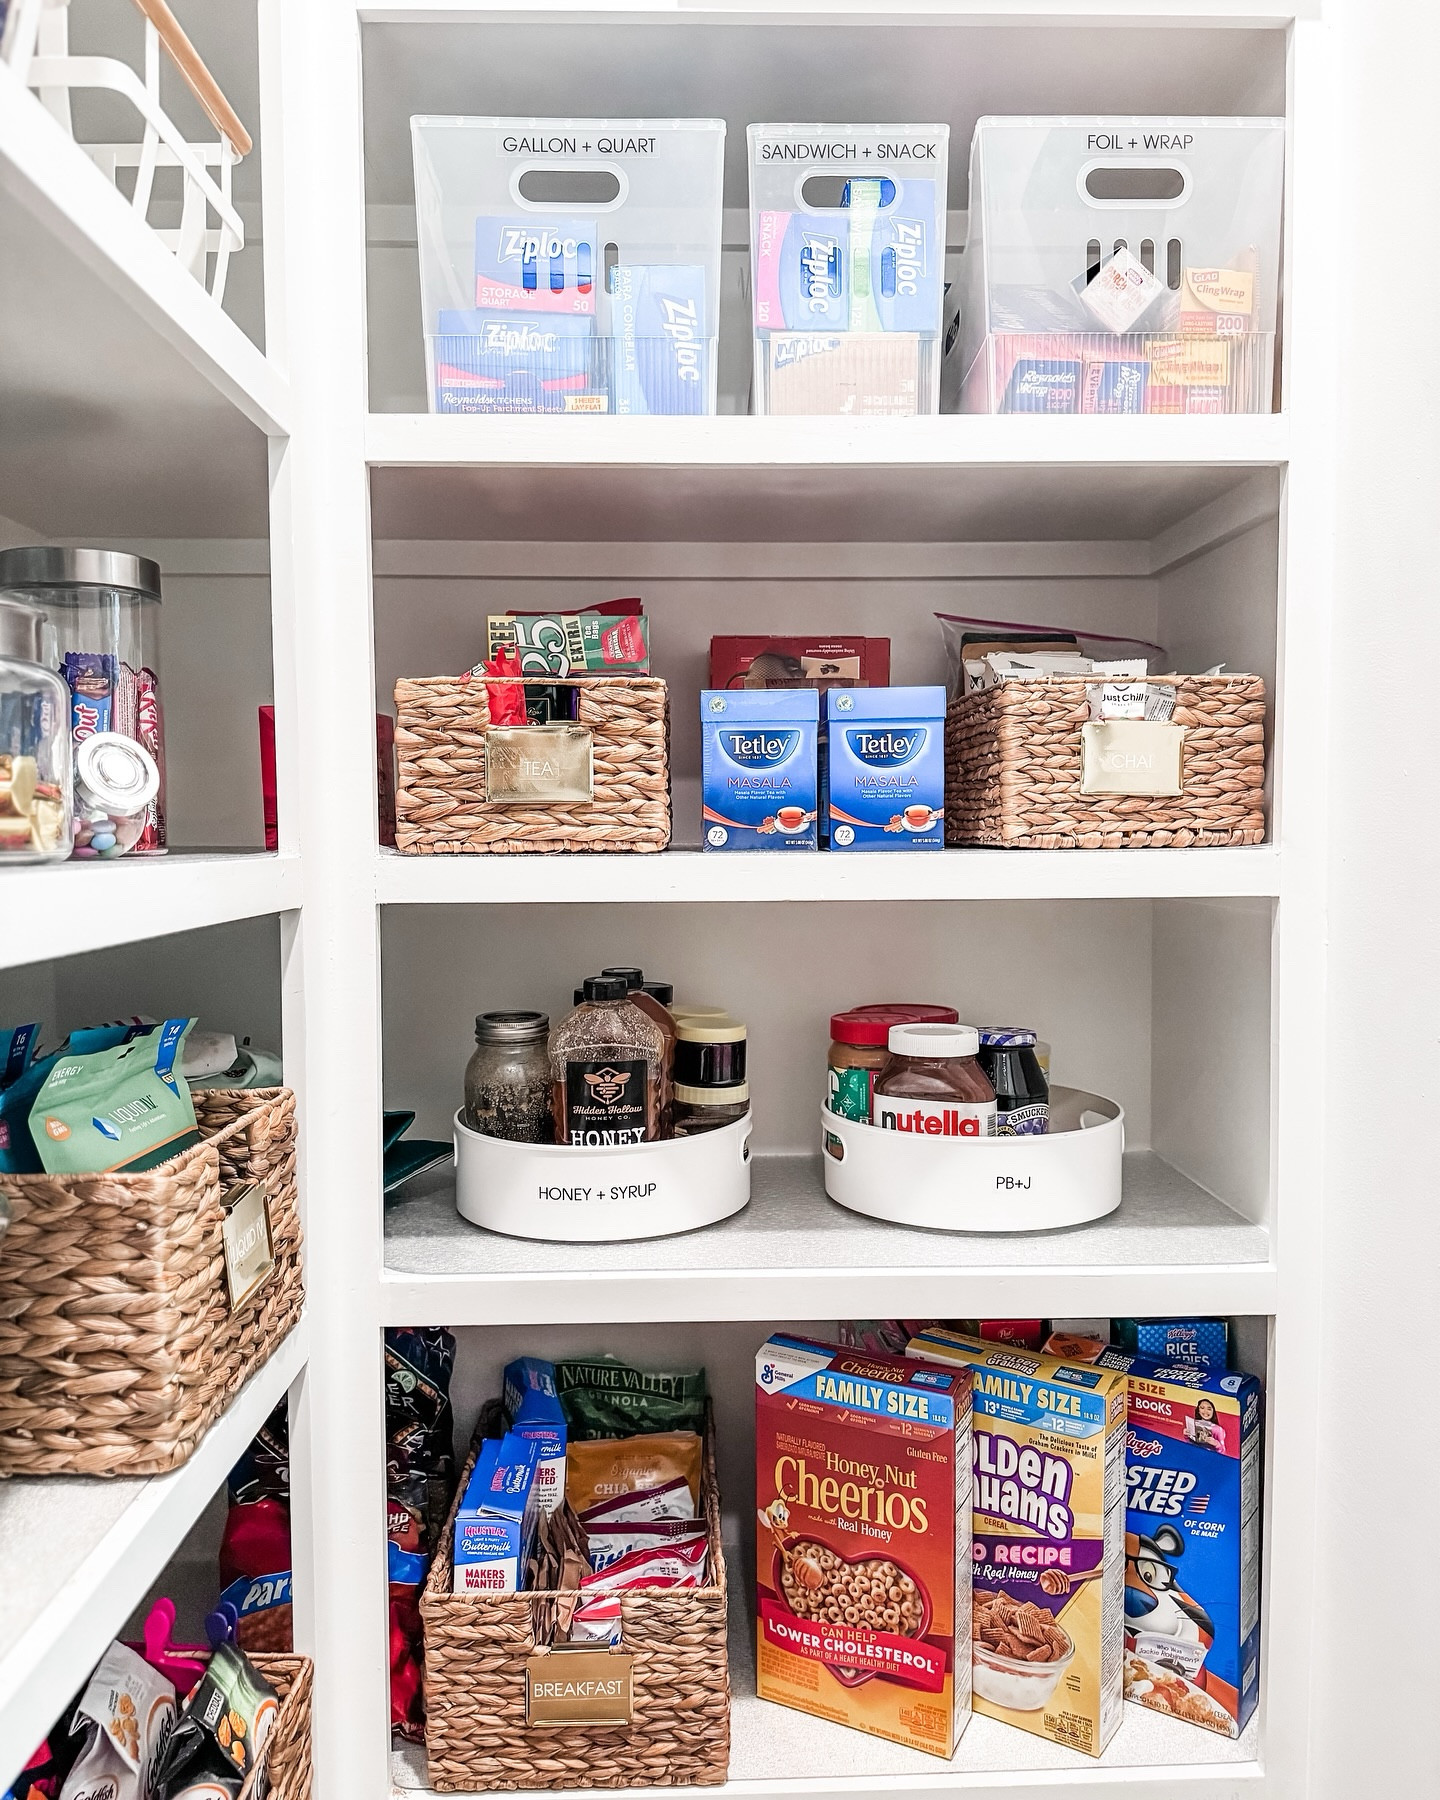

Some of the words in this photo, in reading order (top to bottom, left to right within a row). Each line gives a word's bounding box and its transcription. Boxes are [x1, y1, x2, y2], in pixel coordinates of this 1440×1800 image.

[502, 136, 577, 153] GALLON
[582, 141, 593, 152] +
[597, 137, 657, 154] QUART
[1087, 134, 1124, 150] FOIL
[1127, 138, 1138, 149] +
[1143, 134, 1194, 150] WRAP
[761, 143, 857, 160] SANDWICH
[861, 148, 872, 158] +
[876, 143, 937, 160] SNACK
[760, 214, 774, 257] SNACK
[504, 228, 578, 264] Ziploc
[890, 223, 923, 297] Ziploc
[802, 239, 835, 314] Ziploc
[1192, 271, 1218, 283] GLAD
[480, 286, 537, 301] STORAGE
[621, 269, 634, 302] PARA
[480, 297, 511, 308] QUART
[572, 300, 590, 312] 50
[758, 300, 770, 322] 120
[851, 306, 862, 327] 125
[1217, 316, 1243, 331] 200
[622, 304, 636, 372] CONGELAR
[661, 298, 703, 383] Ziploc
[442, 392, 492, 407] Reynolds
[565, 619, 585, 663] EXTRA
[583, 625, 592, 640] Tea
[513, 618, 571, 679] 25
[1102, 694, 1120, 702] Just
[1122, 693, 1144, 702] Chill
[729, 734, 792, 760] Tetley
[856, 732, 918, 759] Tetley
[522, 760, 554, 776] TEA
[1110, 754, 1153, 769] CHAI
[727, 776, 793, 789] MASALA
[854, 775, 919, 787] MASALA
[712, 830, 723, 840] 72
[839, 829, 851, 839] 72
[16, 1032, 26, 1045] 16
[168, 1024, 181, 1036] 14
[51, 1065, 84, 1081] ENERGY
[108, 1099, 144, 1125] LIQUID
[572, 1105, 607, 1115] Hidden
[608, 1104, 643, 1115] Hollow
[881, 1109, 980, 1137] nutella
[570, 1126, 646, 1147] HONEY
[995, 1175, 1032, 1190] PB+J
[538, 1186, 592, 1201] HONEY
[596, 1190, 606, 1201] +
[610, 1183, 657, 1200] SYRUP
[1166, 1342, 1198, 1356] RICE
[867, 1362, 888, 1372] Honey
[890, 1366, 905, 1374] Nut
[1098, 1361, 1130, 1372] SPORTS
[1101, 1357, 1132, 1368] SCHOOL
[1104, 1354, 1135, 1365] SUPPORT
[774, 1370, 794, 1379] General
[839, 1360, 905, 1383] Cheerios
[1153, 1368, 1208, 1378] FROSTED
[562, 1365, 620, 1389] NATURE
[621, 1370, 678, 1398] VALLEY
[1138, 1381, 1166, 1396] SIZE
[588, 1390, 649, 1408] GRANOLA
[816, 1375, 884, 1410] FAMILY
[887, 1391, 929, 1420] SIZE
[973, 1371, 1034, 1405] AMILY
[1037, 1388, 1082, 1418] SIZE
[1135, 1397, 1173, 1417] BOOKS
[901, 1422, 912, 1436] 12
[1051, 1417, 1065, 1432] 12
[776, 1432, 801, 1446] NATURALLY
[801, 1438, 826, 1451] FLAVORED
[1028, 1437, 1050, 1448] Graham
[1050, 1443, 1074, 1454] Crackers
[1082, 1450, 1097, 1459] Milk!
[1039, 1433, 1049, 1441] The
[1050, 1435, 1075, 1448] Delicious
[1075, 1441, 1090, 1451] Taste
[906, 1446, 932, 1460] Gluten
[932, 1451, 948, 1464] Free
[506, 1464, 526, 1494] Buttermilk
[826, 1451, 879, 1481] Honey
[885, 1464, 918, 1490] Nut
[1126, 1465, 1197, 1494] STED
[594, 1483, 629, 1495] CHIA
[774, 1456, 929, 1534] Cheerios
[837, 1517, 859, 1533] Real
[860, 1522, 893, 1544] Honey
[983, 1516, 1009, 1531] CEREAL
[1183, 1519, 1197, 1528] OF
[1198, 1521, 1226, 1532] CORN
[1201, 1529, 1219, 1539] MAÍZ
[461, 1540, 511, 1552] Buttermilk
[994, 1543, 1072, 1567] RECIPE
[465, 1569, 505, 1579] MAKERS
[983, 1564, 1006, 1581] Real
[1008, 1566, 1039, 1582] Honey
[465, 1579, 505, 1589] WANTED
[820, 1626, 844, 1639] CAN
[847, 1628, 877, 1643] HELP
[768, 1618, 821, 1648] LOWER
[823, 1638, 936, 1674] CHOLESTEROL
[800, 1647, 809, 1655] AS
[809, 1648, 824, 1660] PART
[824, 1651, 833, 1661] OF
[839, 1654, 858, 1666] HEART
[860, 1657, 886, 1671] HEALTHY
[886, 1662, 900, 1673] DIET
[1138, 1647, 1160, 1656] Jackie
[1160, 1651, 1200, 1664] Robinson?
[533, 1680, 624, 1698] BREAKFAST
[206, 1691, 223, 1722] CHEDDAR
